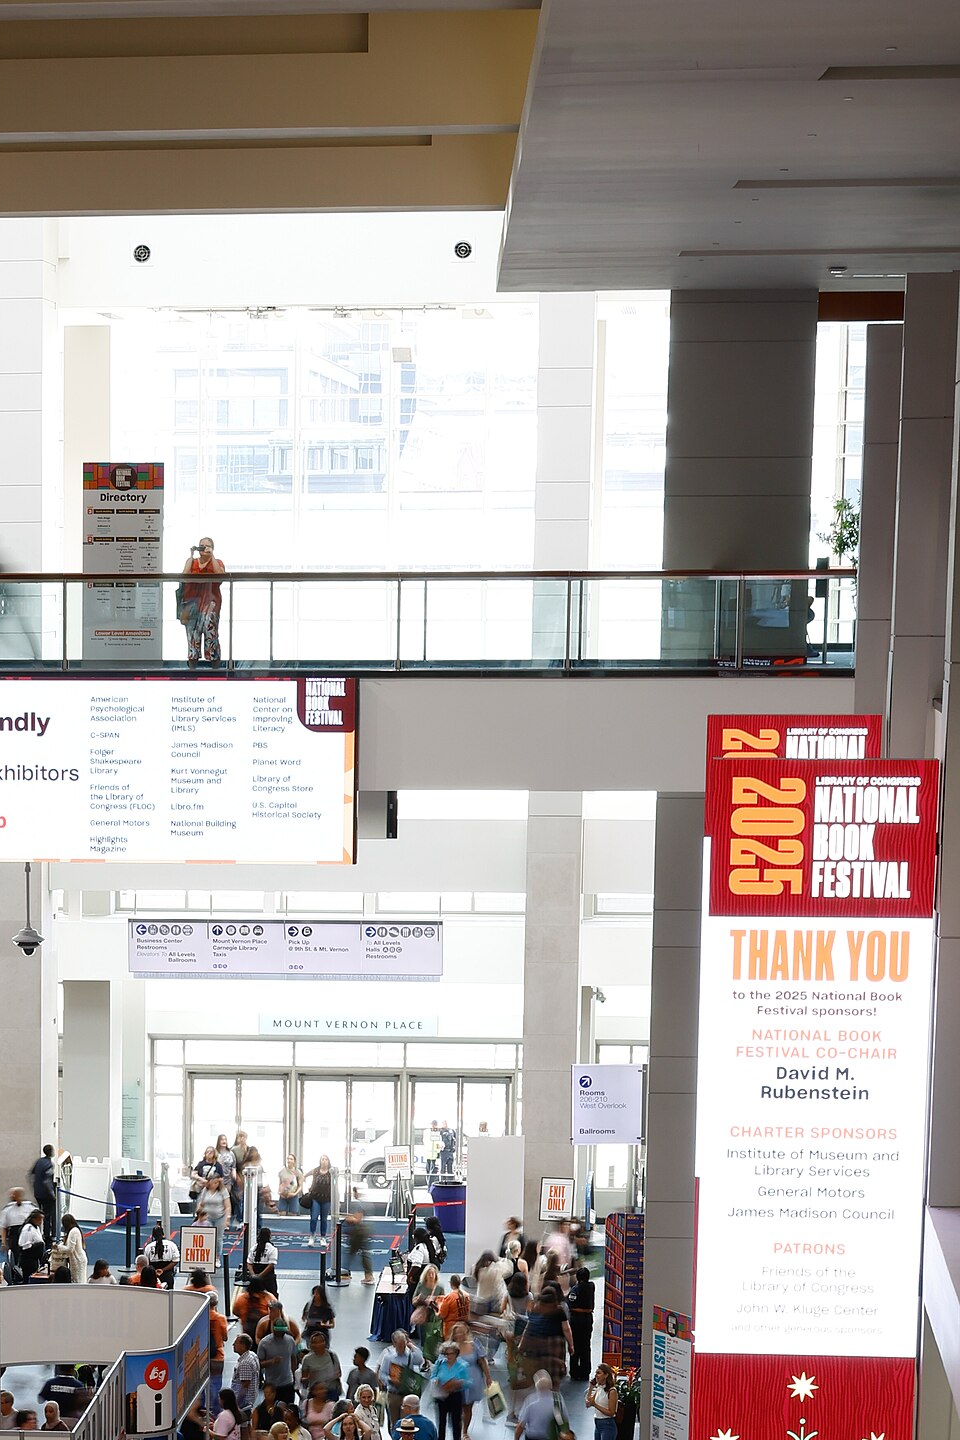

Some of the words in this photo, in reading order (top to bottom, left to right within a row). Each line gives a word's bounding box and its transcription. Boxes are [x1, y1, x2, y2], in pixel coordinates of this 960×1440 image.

[100, 493, 147, 503] Directory
[306, 681, 346, 696] NATIONAL
[90, 706, 145, 714] Psychological
[253, 716, 293, 724] Improving
[305, 710, 344, 725] FESTIVAL
[253, 725, 285, 733] Literacy
[90, 749, 114, 757] Folger
[90, 758, 142, 766] Shakespeare
[252, 776, 280, 784] Library
[815, 776, 856, 786] LIBRARY
[856, 777, 870, 786] OF
[869, 777, 921, 786] CONGRESS
[252, 785, 290, 793] Congress
[105, 793, 134, 801] Library
[90, 803, 127, 811] Congress
[129, 803, 156, 811] (FLOC)
[814, 786, 920, 824] NATIONAL
[292, 811, 322, 820] Society
[90, 836, 128, 845] Highlights
[728, 777, 807, 896] 2025
[812, 824, 876, 861] BOOK
[90, 846, 127, 854] Magazine
[811, 861, 911, 898] FESTIVAL
[730, 930, 836, 981] THANK
[846, 930, 911, 982] YOU
[732, 991, 745, 1000] to
[750, 991, 771, 1000] the
[775, 991, 808, 1000] 2025
[812, 991, 866, 1001] National
[870, 992, 903, 1001] Book
[757, 1006, 808, 1016] Festival
[812, 1007, 877, 1017] sponsors!
[273, 1019, 320, 1029] MOUNT
[326, 1020, 379, 1029] VERNON
[385, 1021, 424, 1030] PLACE
[752, 1029, 831, 1041] NATIONAL
[838, 1030, 882, 1042] BOOK
[736, 1046, 809, 1058] FESTIVAL
[816, 1047, 897, 1059] CO-CHAIR
[776, 1066, 829, 1080] David
[836, 1067, 855, 1081] M.
[761, 1085, 869, 1100] Rubenstein
[730, 1126, 804, 1138] CHARTER
[810, 1127, 898, 1140] SPONSORS
[727, 1148, 786, 1159] Institute
[790, 1149, 804, 1160] of
[809, 1150, 867, 1160] Museum
[872, 1150, 899, 1161] and
[754, 1164, 804, 1178] Library
[808, 1166, 870, 1177] Services
[549, 1185, 565, 1198] EXIT
[758, 1186, 812, 1197] General
[817, 1187, 865, 1198] Motors
[547, 1198, 566, 1211] ONLY
[727, 1207, 774, 1218] James
[779, 1208, 837, 1219] Madison
[842, 1209, 895, 1220] Council
[193, 1235, 204, 1248] NO
[185, 1248, 210, 1262] ENTRY
[774, 1242, 846, 1255] PATRONS
[654, 1334, 666, 1373] WEST
[652, 1373, 665, 1419] SALON
